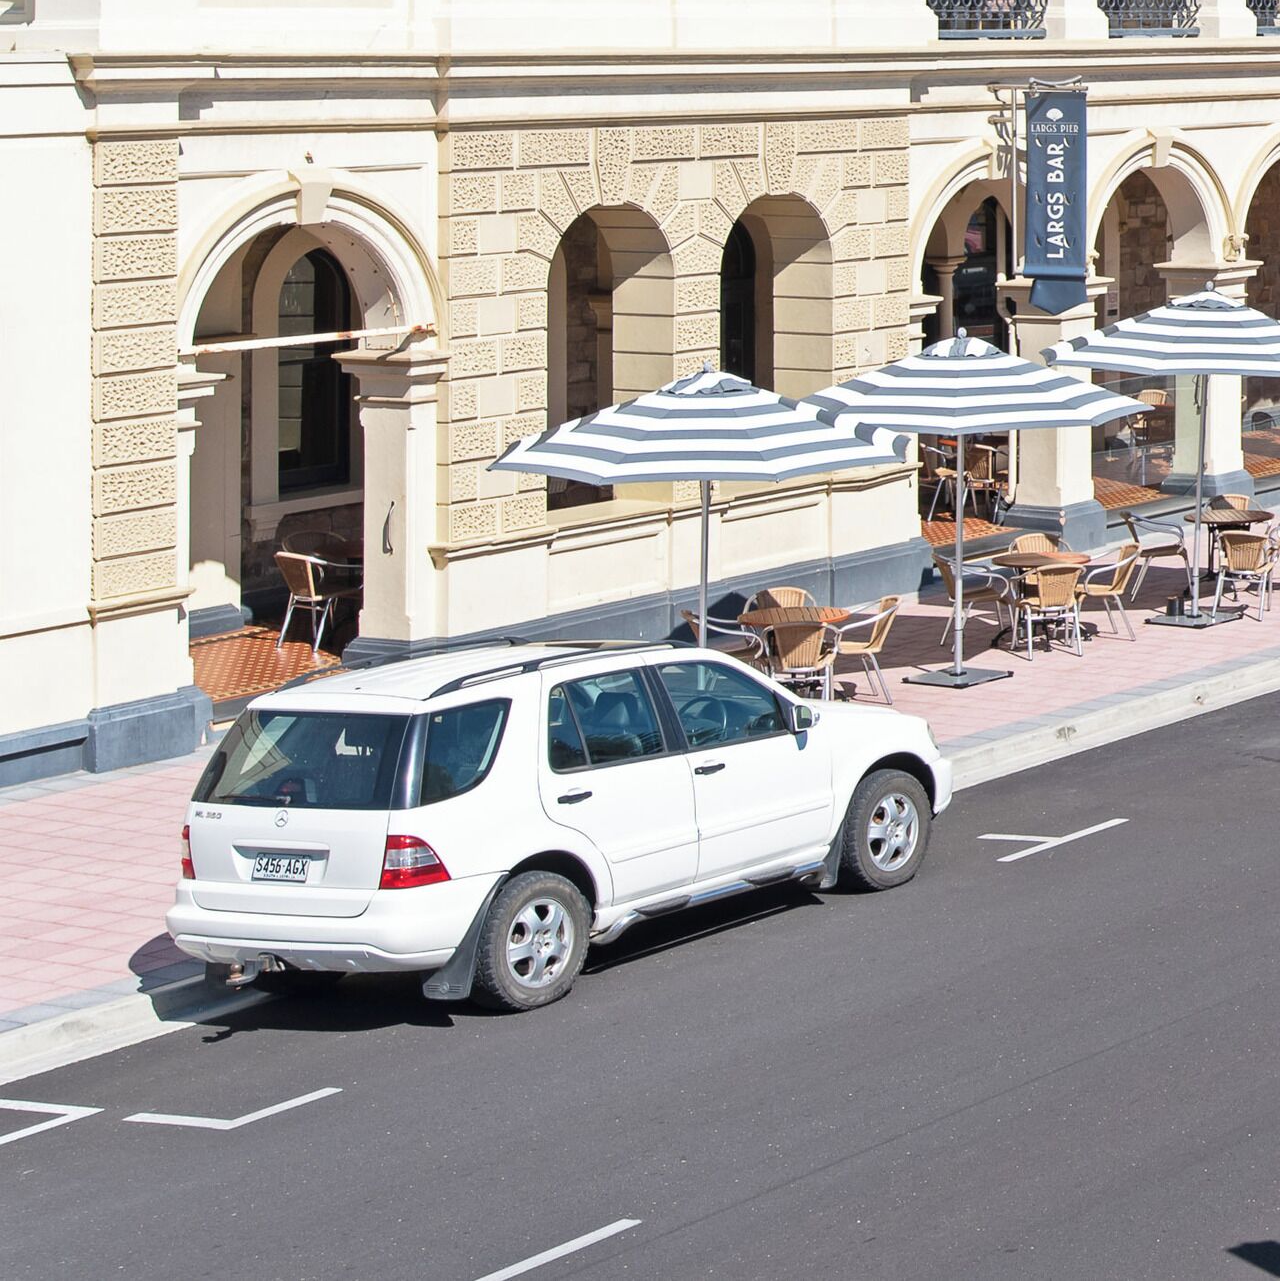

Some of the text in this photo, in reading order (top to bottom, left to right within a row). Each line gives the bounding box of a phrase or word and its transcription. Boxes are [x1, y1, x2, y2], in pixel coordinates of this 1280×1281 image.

[1031, 124, 1079, 133] LARGS PIER
[1046, 142, 1065, 259] LARGS BAR
